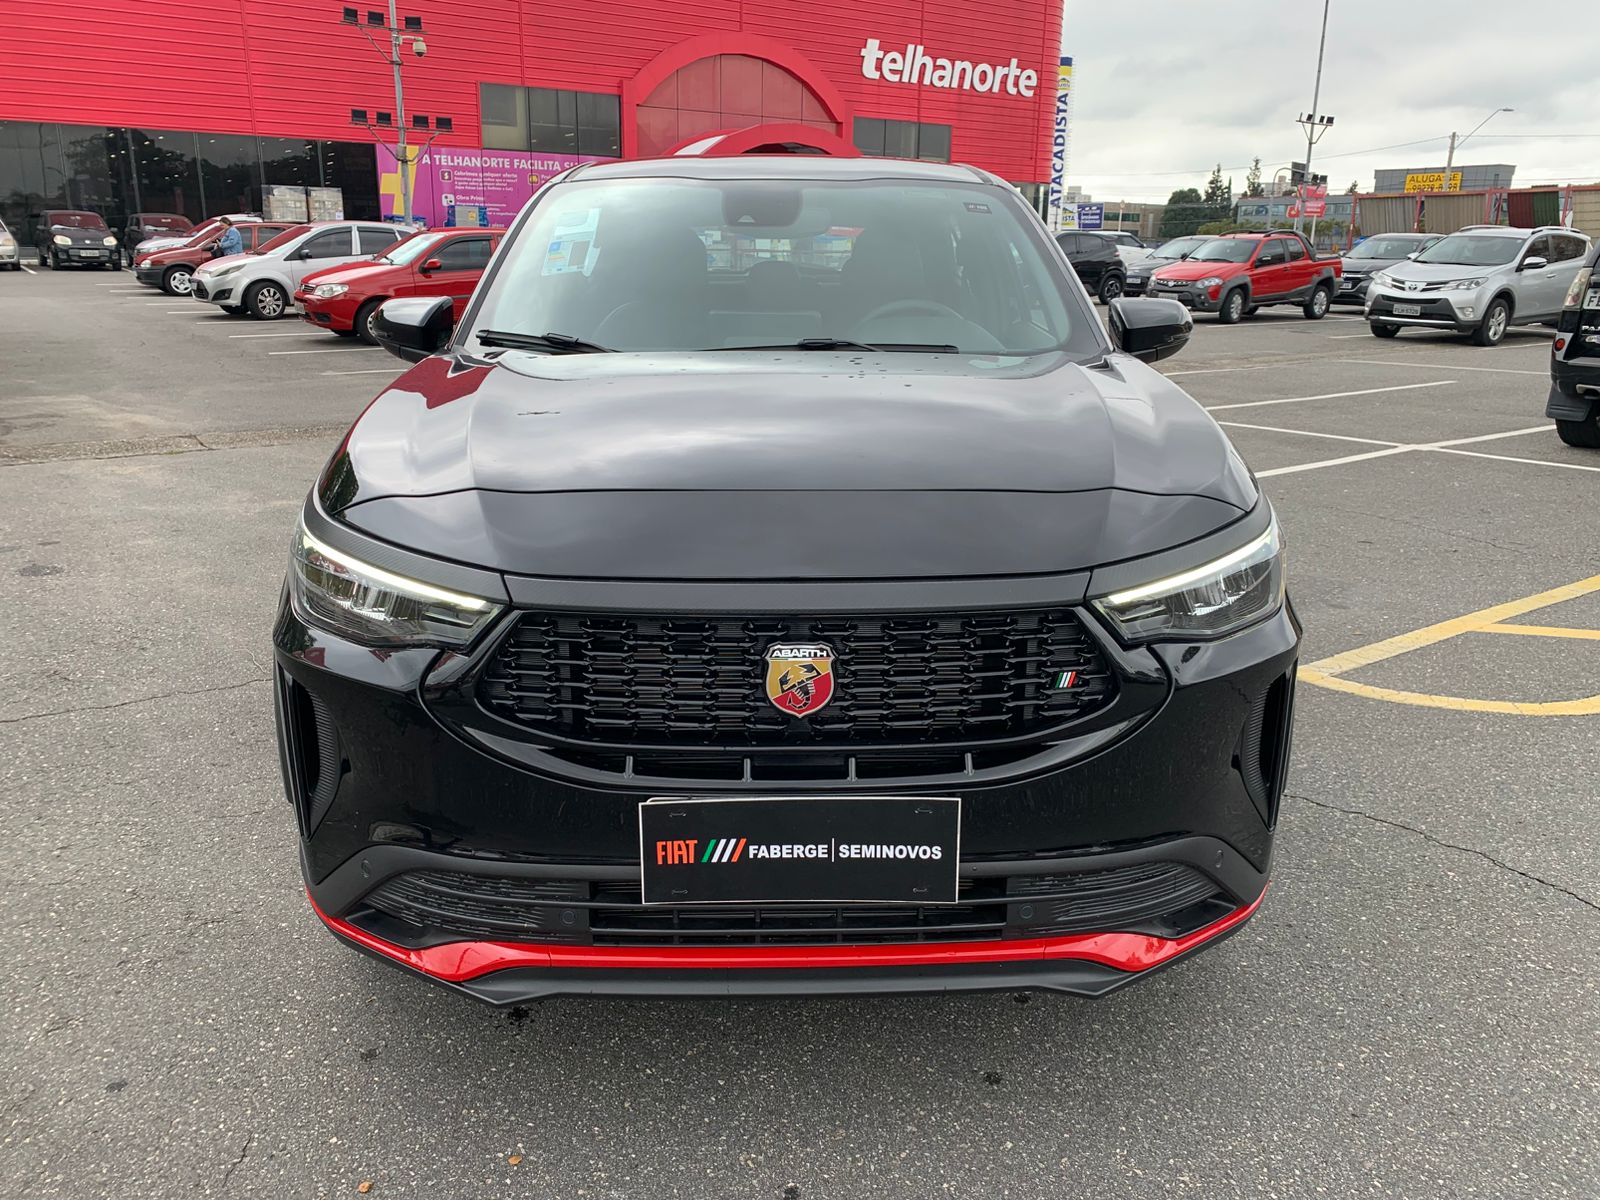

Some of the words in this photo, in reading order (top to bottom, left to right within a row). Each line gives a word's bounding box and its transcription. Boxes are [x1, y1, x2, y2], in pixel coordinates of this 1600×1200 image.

[861, 38, 1038, 98] telhanorte
[1050, 92, 1069, 208] ATACADISTA
[422, 155, 431, 165] A
[433, 155, 511, 168] TELHANORTE
[513, 159, 562, 171] FACILITA
[1409, 173, 1460, 183] ALUGA-E
[772, 649, 827, 658] ABARTH
[656, 839, 698, 864] FIAT
[748, 844, 828, 859] FABERGE
[838, 844, 942, 861] SEMINOVOS
